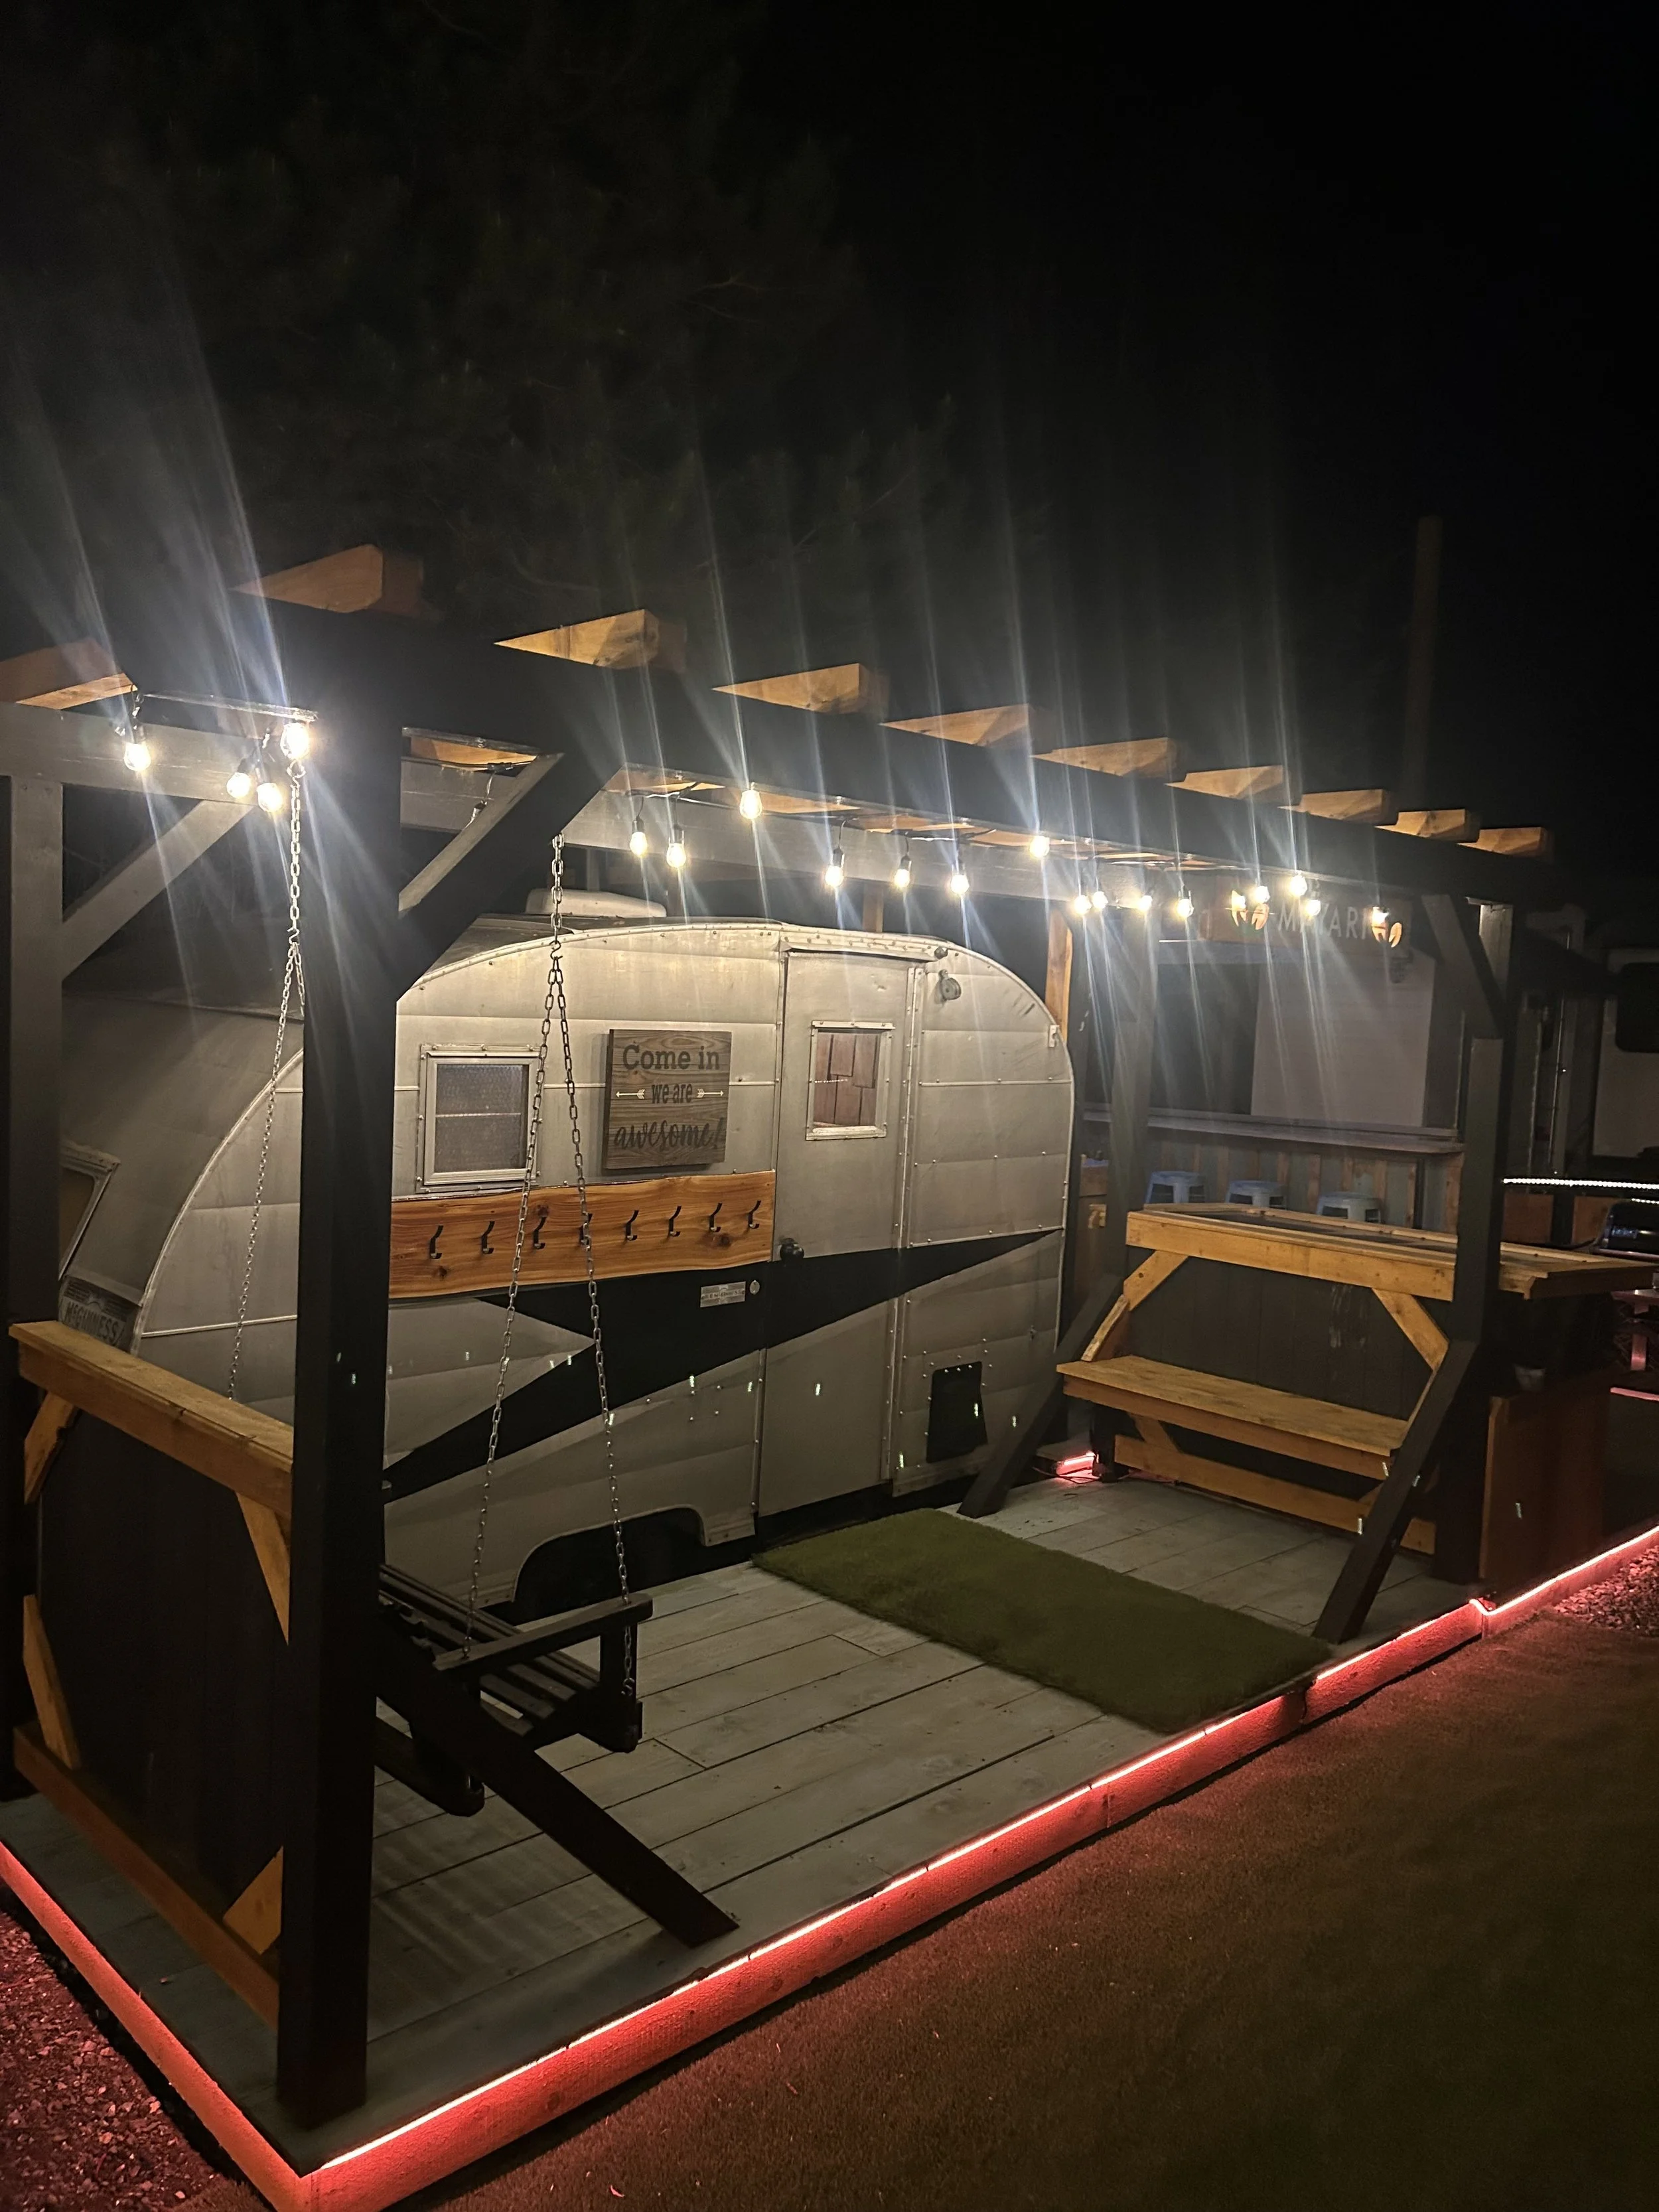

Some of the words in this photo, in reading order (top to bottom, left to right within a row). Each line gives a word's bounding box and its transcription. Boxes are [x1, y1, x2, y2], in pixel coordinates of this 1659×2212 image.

[622, 1044, 691, 1070] Come
[698, 1046, 721, 1070] in
[651, 1084, 670, 1104] we
[673, 1082, 693, 1104] are
[614, 1118, 726, 1150] awesome!
